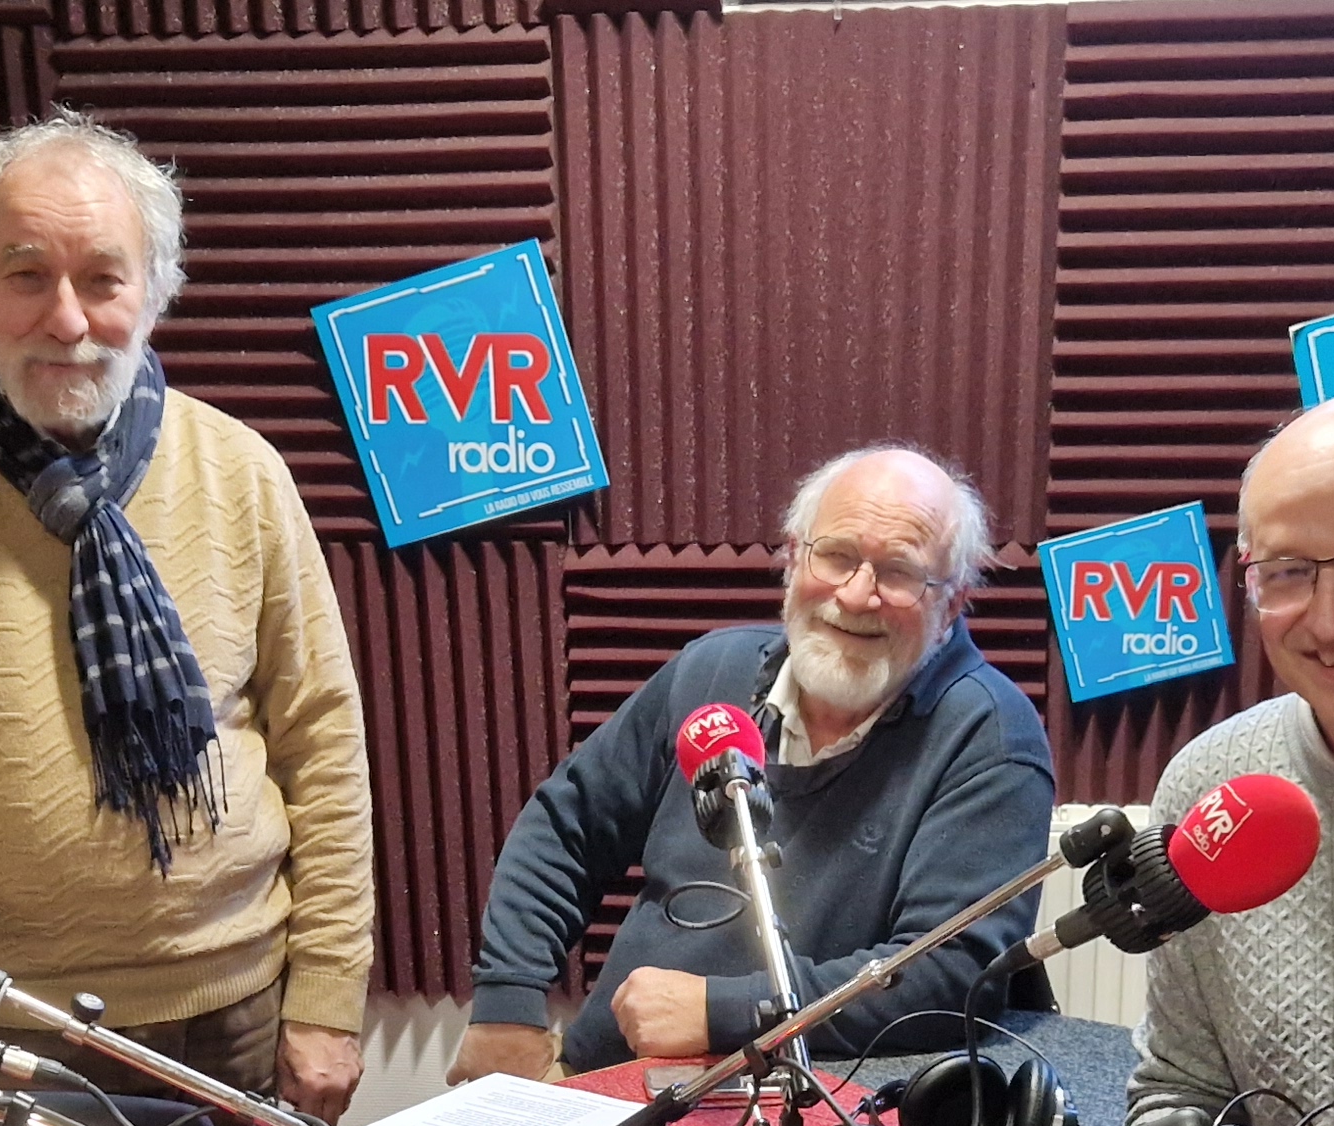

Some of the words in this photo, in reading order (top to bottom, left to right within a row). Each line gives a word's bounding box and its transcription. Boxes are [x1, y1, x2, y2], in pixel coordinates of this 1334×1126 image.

[363, 333, 553, 425] RVR
[448, 425, 556, 474] radio
[550, 474, 595, 496] RESSEMBLE
[1069, 561, 1202, 623] RVR
[1122, 625, 1198, 656] radio
[688, 711, 730, 740] RVR
[1198, 788, 1234, 843] RVR
